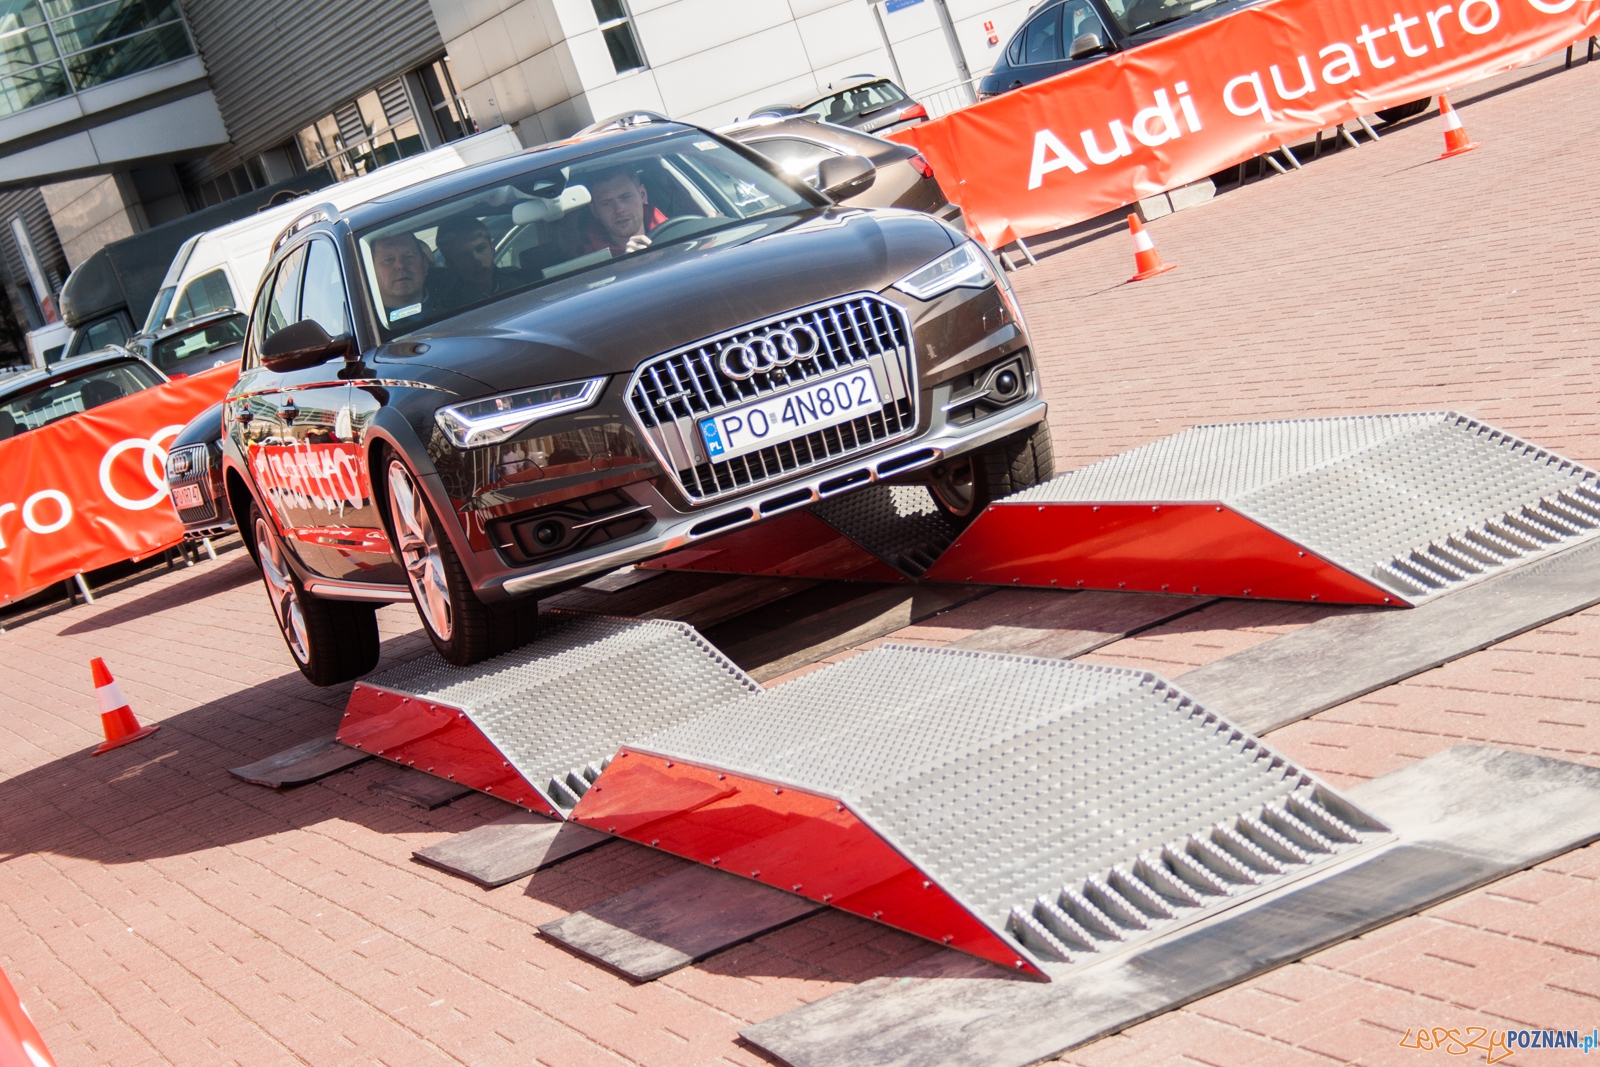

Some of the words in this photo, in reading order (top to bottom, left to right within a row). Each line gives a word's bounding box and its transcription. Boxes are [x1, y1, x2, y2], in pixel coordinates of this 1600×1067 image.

[1027, 80, 1202, 190] Audi
[1222, 0, 1500, 123] quattro
[709, 441, 723, 452] PL
[721, 408, 770, 448] PO
[781, 375, 873, 426] 4N802
